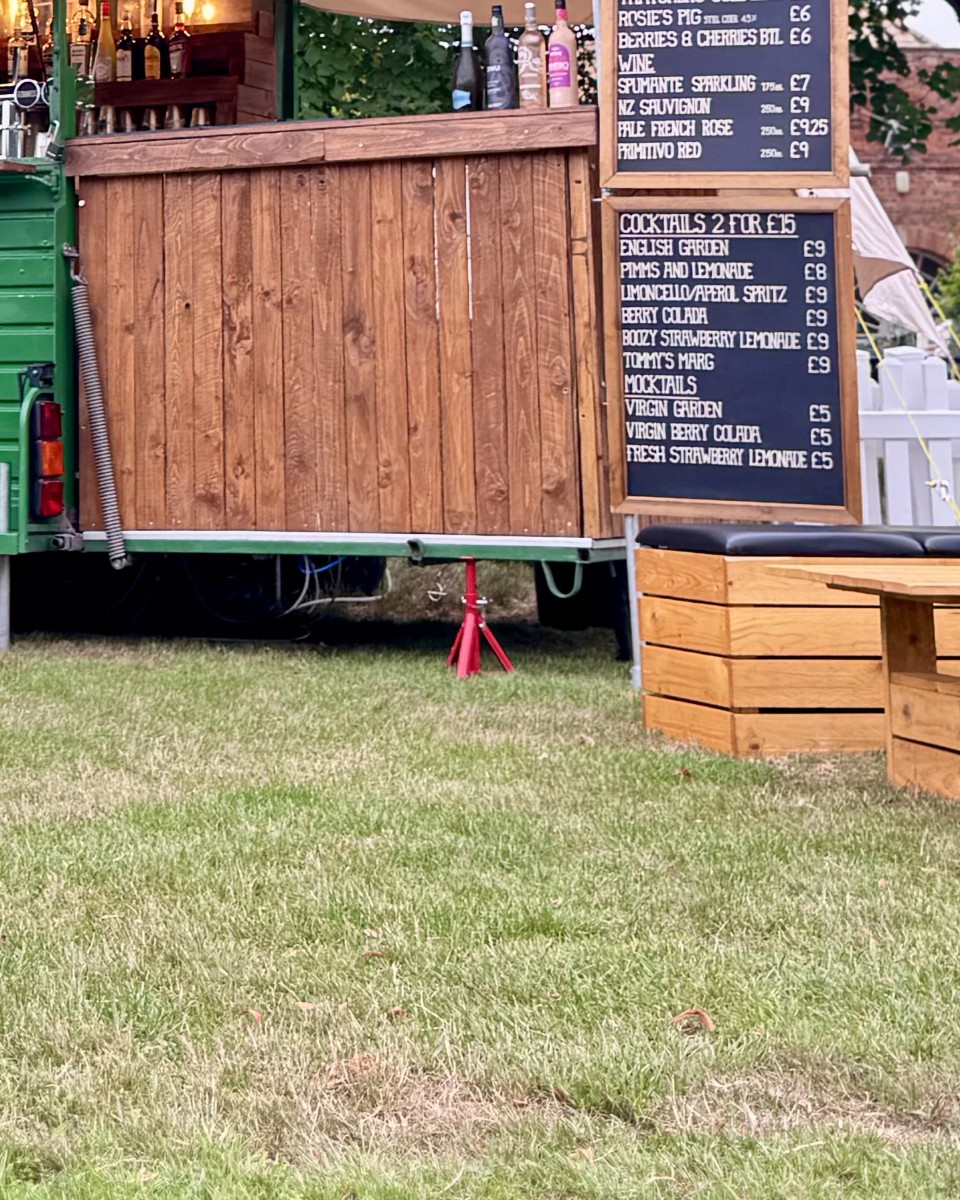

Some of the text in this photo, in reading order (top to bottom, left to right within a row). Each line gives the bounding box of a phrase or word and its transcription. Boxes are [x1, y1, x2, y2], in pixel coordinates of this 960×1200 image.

[618, 9, 673, 26] ROSIE'S
[677, 9, 702, 25] PIG
[790, 5, 811, 22] £6
[618, 28, 812, 49] BERRIES & CHERRIES BTL £6
[618, 54, 655, 73] WINE
[618, 76, 684, 94] SPUMANTE
[692, 74, 756, 92] SPARKLING
[790, 74, 810, 92] £7
[618, 100, 636, 115] NZ
[639, 98, 712, 114] SAUVIGNON
[790, 96, 810, 114] £9
[618, 121, 646, 137] PALE
[651, 120, 696, 136] FRENCH
[702, 120, 734, 136] ROSE
[618, 142, 674, 160] PRIMITIVO
[678, 142, 702, 158] RED
[790, 141, 809, 158] £9
[620, 213, 796, 234] COCKTAILS 2 FOR £15
[620, 239, 826, 257] ENGLISH GARDEN £9
[621, 262, 827, 280] PIMMS AND LEMONADE £8
[621, 285, 828, 304] LIMONCELLO/APEROL SPRITZ £9
[622, 307, 828, 327] BERRY COLADA £9
[623, 329, 829, 351] BOOZY STRAWBERRY LEMONADE £9
[623, 352, 831, 374] TOMMY'S MARG £9
[624, 375, 698, 396] MOCKTAILS
[626, 400, 831, 423] VIRGIN GARDEN £5
[626, 422, 832, 446] VIRGIN BERRY COLADA £5
[626, 446, 834, 469] FRESH STRAWBERRY LEMONADE £5
